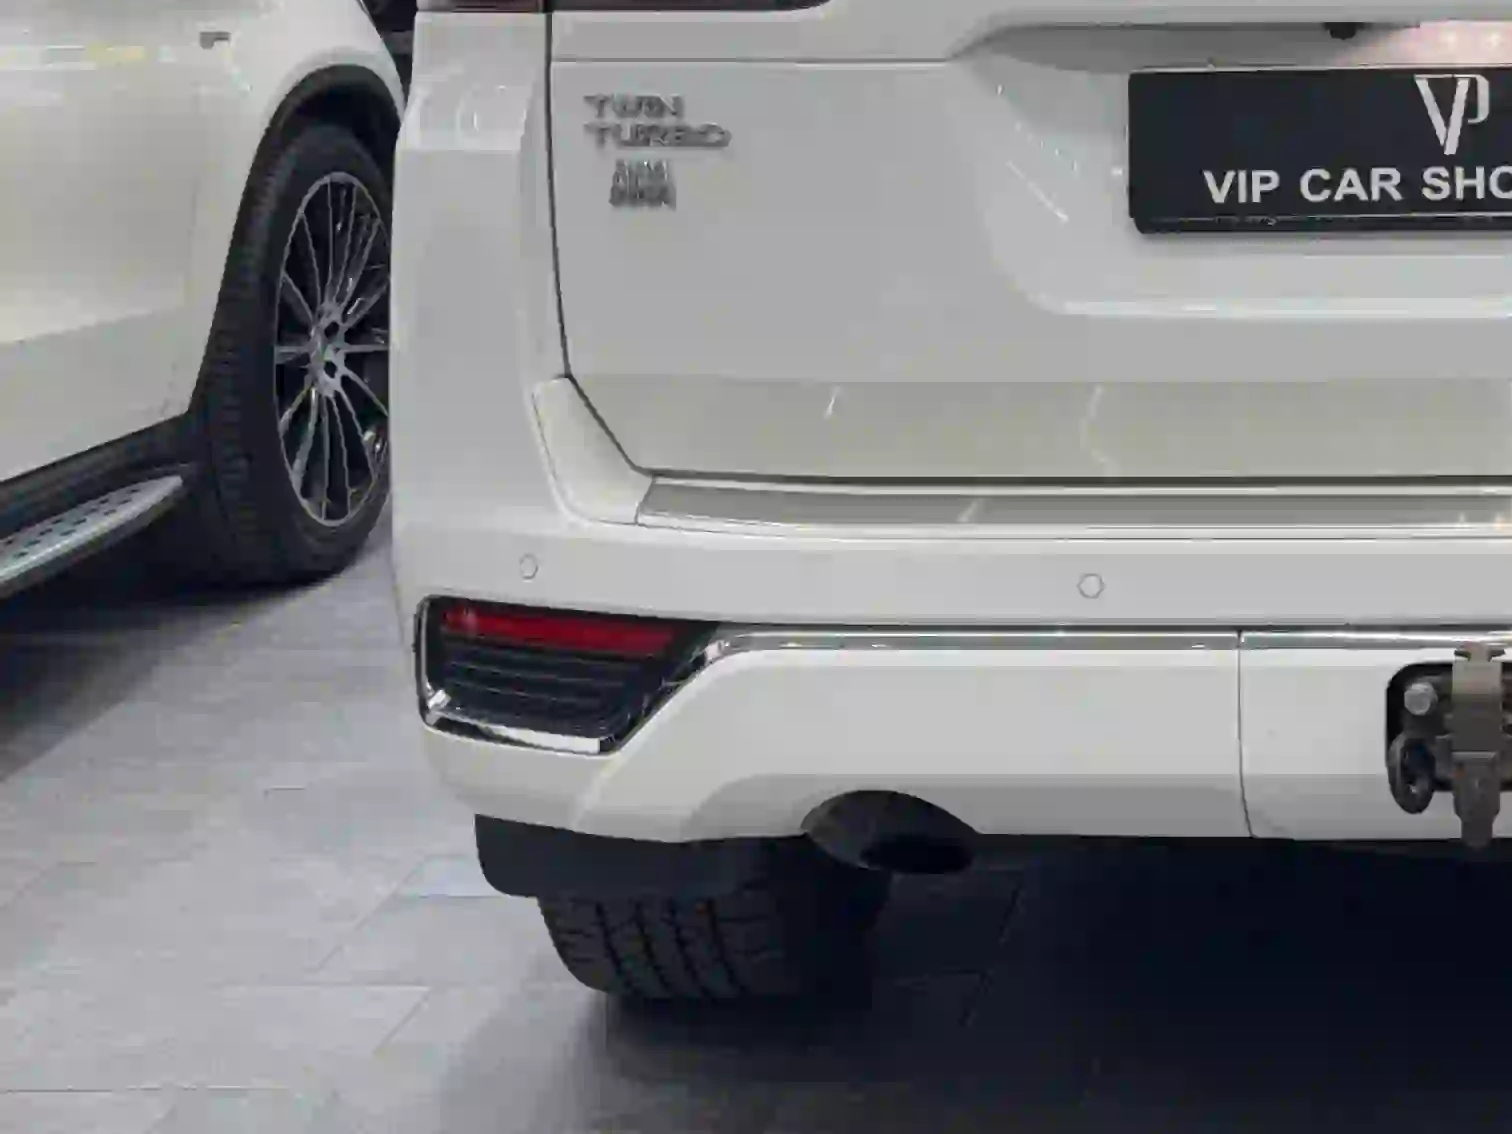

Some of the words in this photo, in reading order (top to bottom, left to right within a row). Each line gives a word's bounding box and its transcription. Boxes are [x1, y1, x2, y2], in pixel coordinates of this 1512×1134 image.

[583, 121, 733, 148] TURBO
[1203, 169, 1281, 204] VIP
[1299, 167, 1403, 203] CAR
